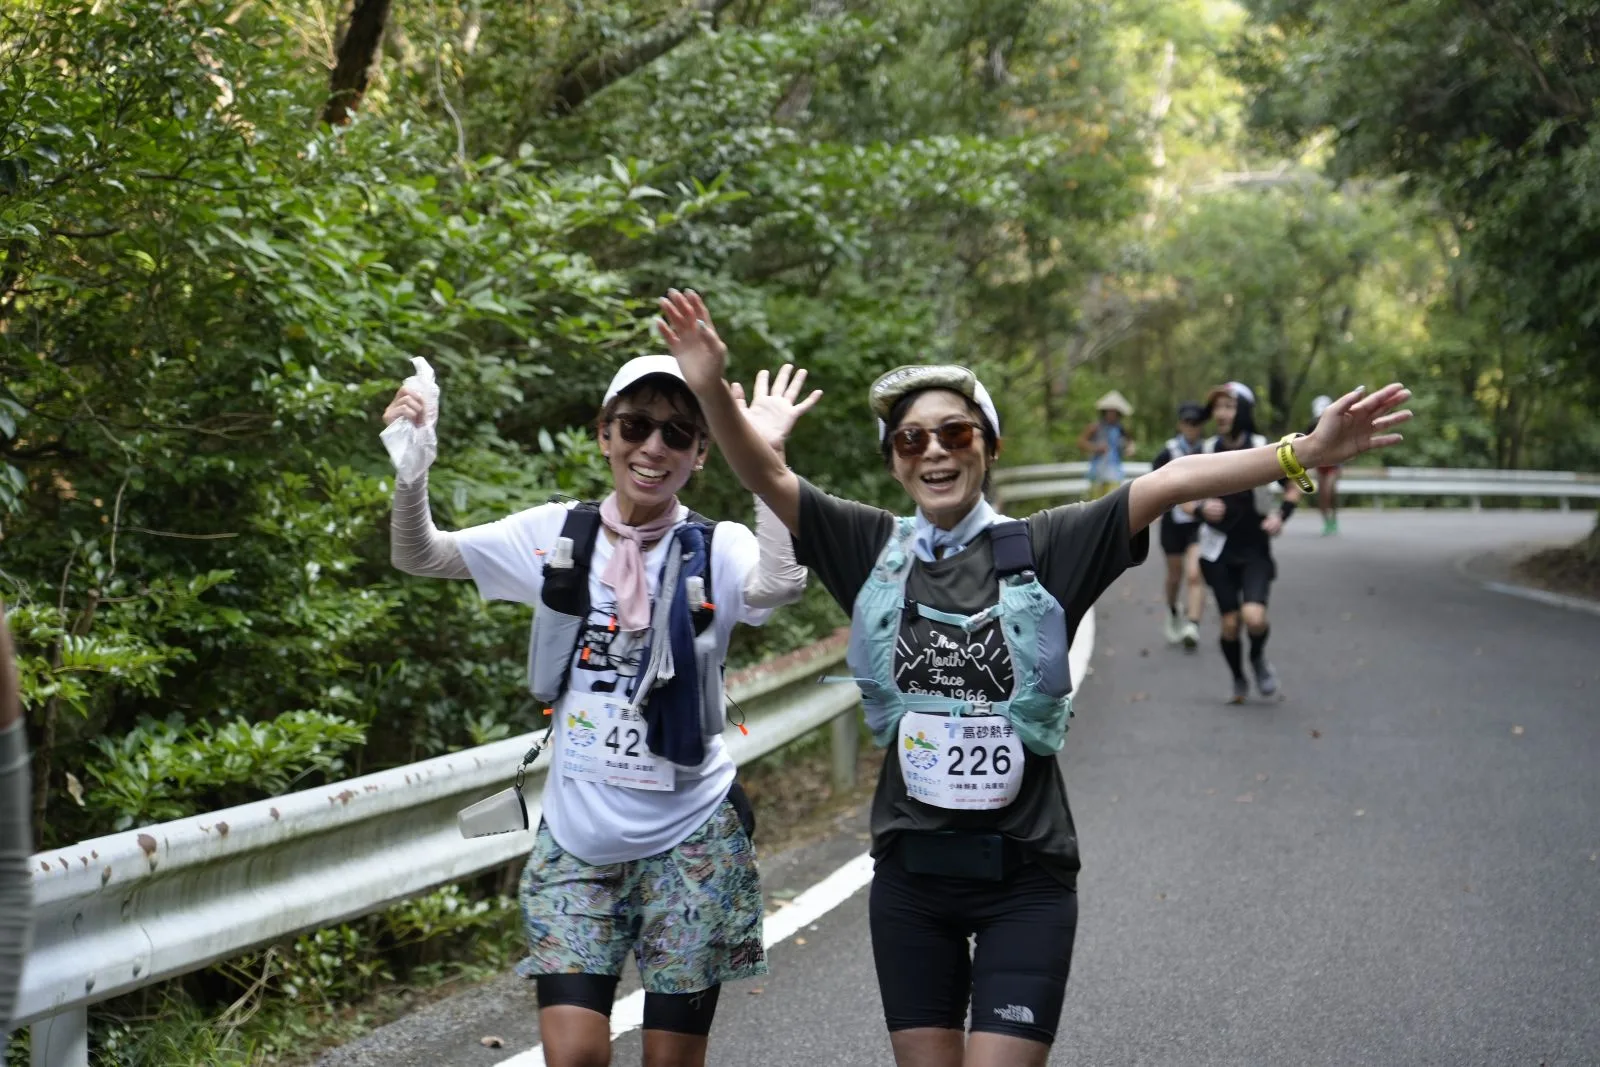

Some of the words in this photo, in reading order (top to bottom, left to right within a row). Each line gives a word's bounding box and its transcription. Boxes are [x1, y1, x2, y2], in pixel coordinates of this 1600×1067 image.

[930, 631, 959, 650] The
[923, 647, 965, 668] North
[928, 668, 965, 686] Face
[907, 681, 945, 697] Since
[950, 689, 987, 702] 1966
[605, 725, 640, 757] 42
[962, 725, 1014, 739] 高砂熱学
[947, 745, 1012, 776] 226
